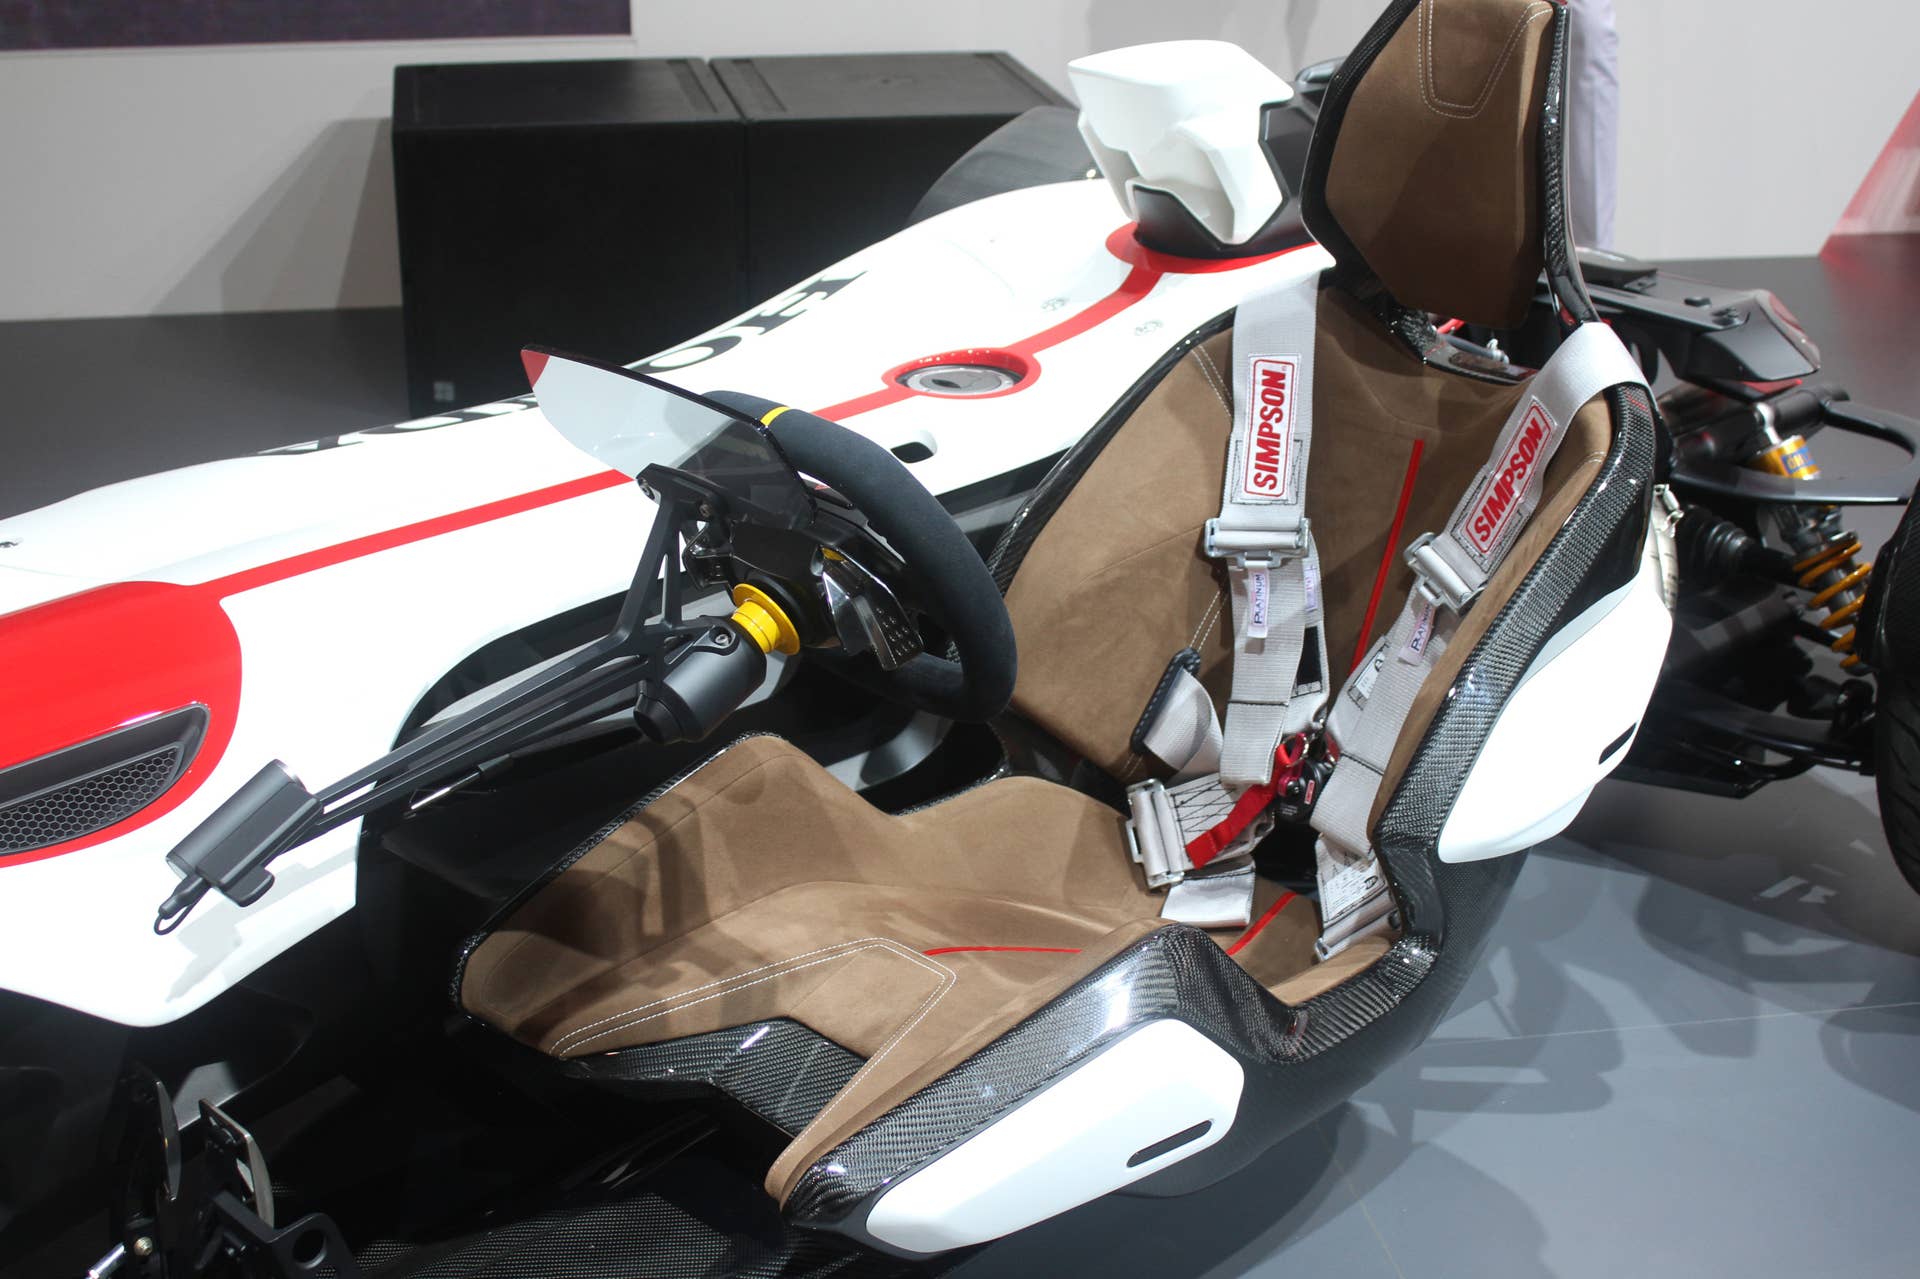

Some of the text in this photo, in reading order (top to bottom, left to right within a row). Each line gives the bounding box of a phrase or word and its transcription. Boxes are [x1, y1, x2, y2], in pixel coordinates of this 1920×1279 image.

[1253, 369, 1286, 490] SIMPSON
[1474, 417, 1543, 542] SIMPSON
[1254, 574, 1263, 624] PLATINUM
